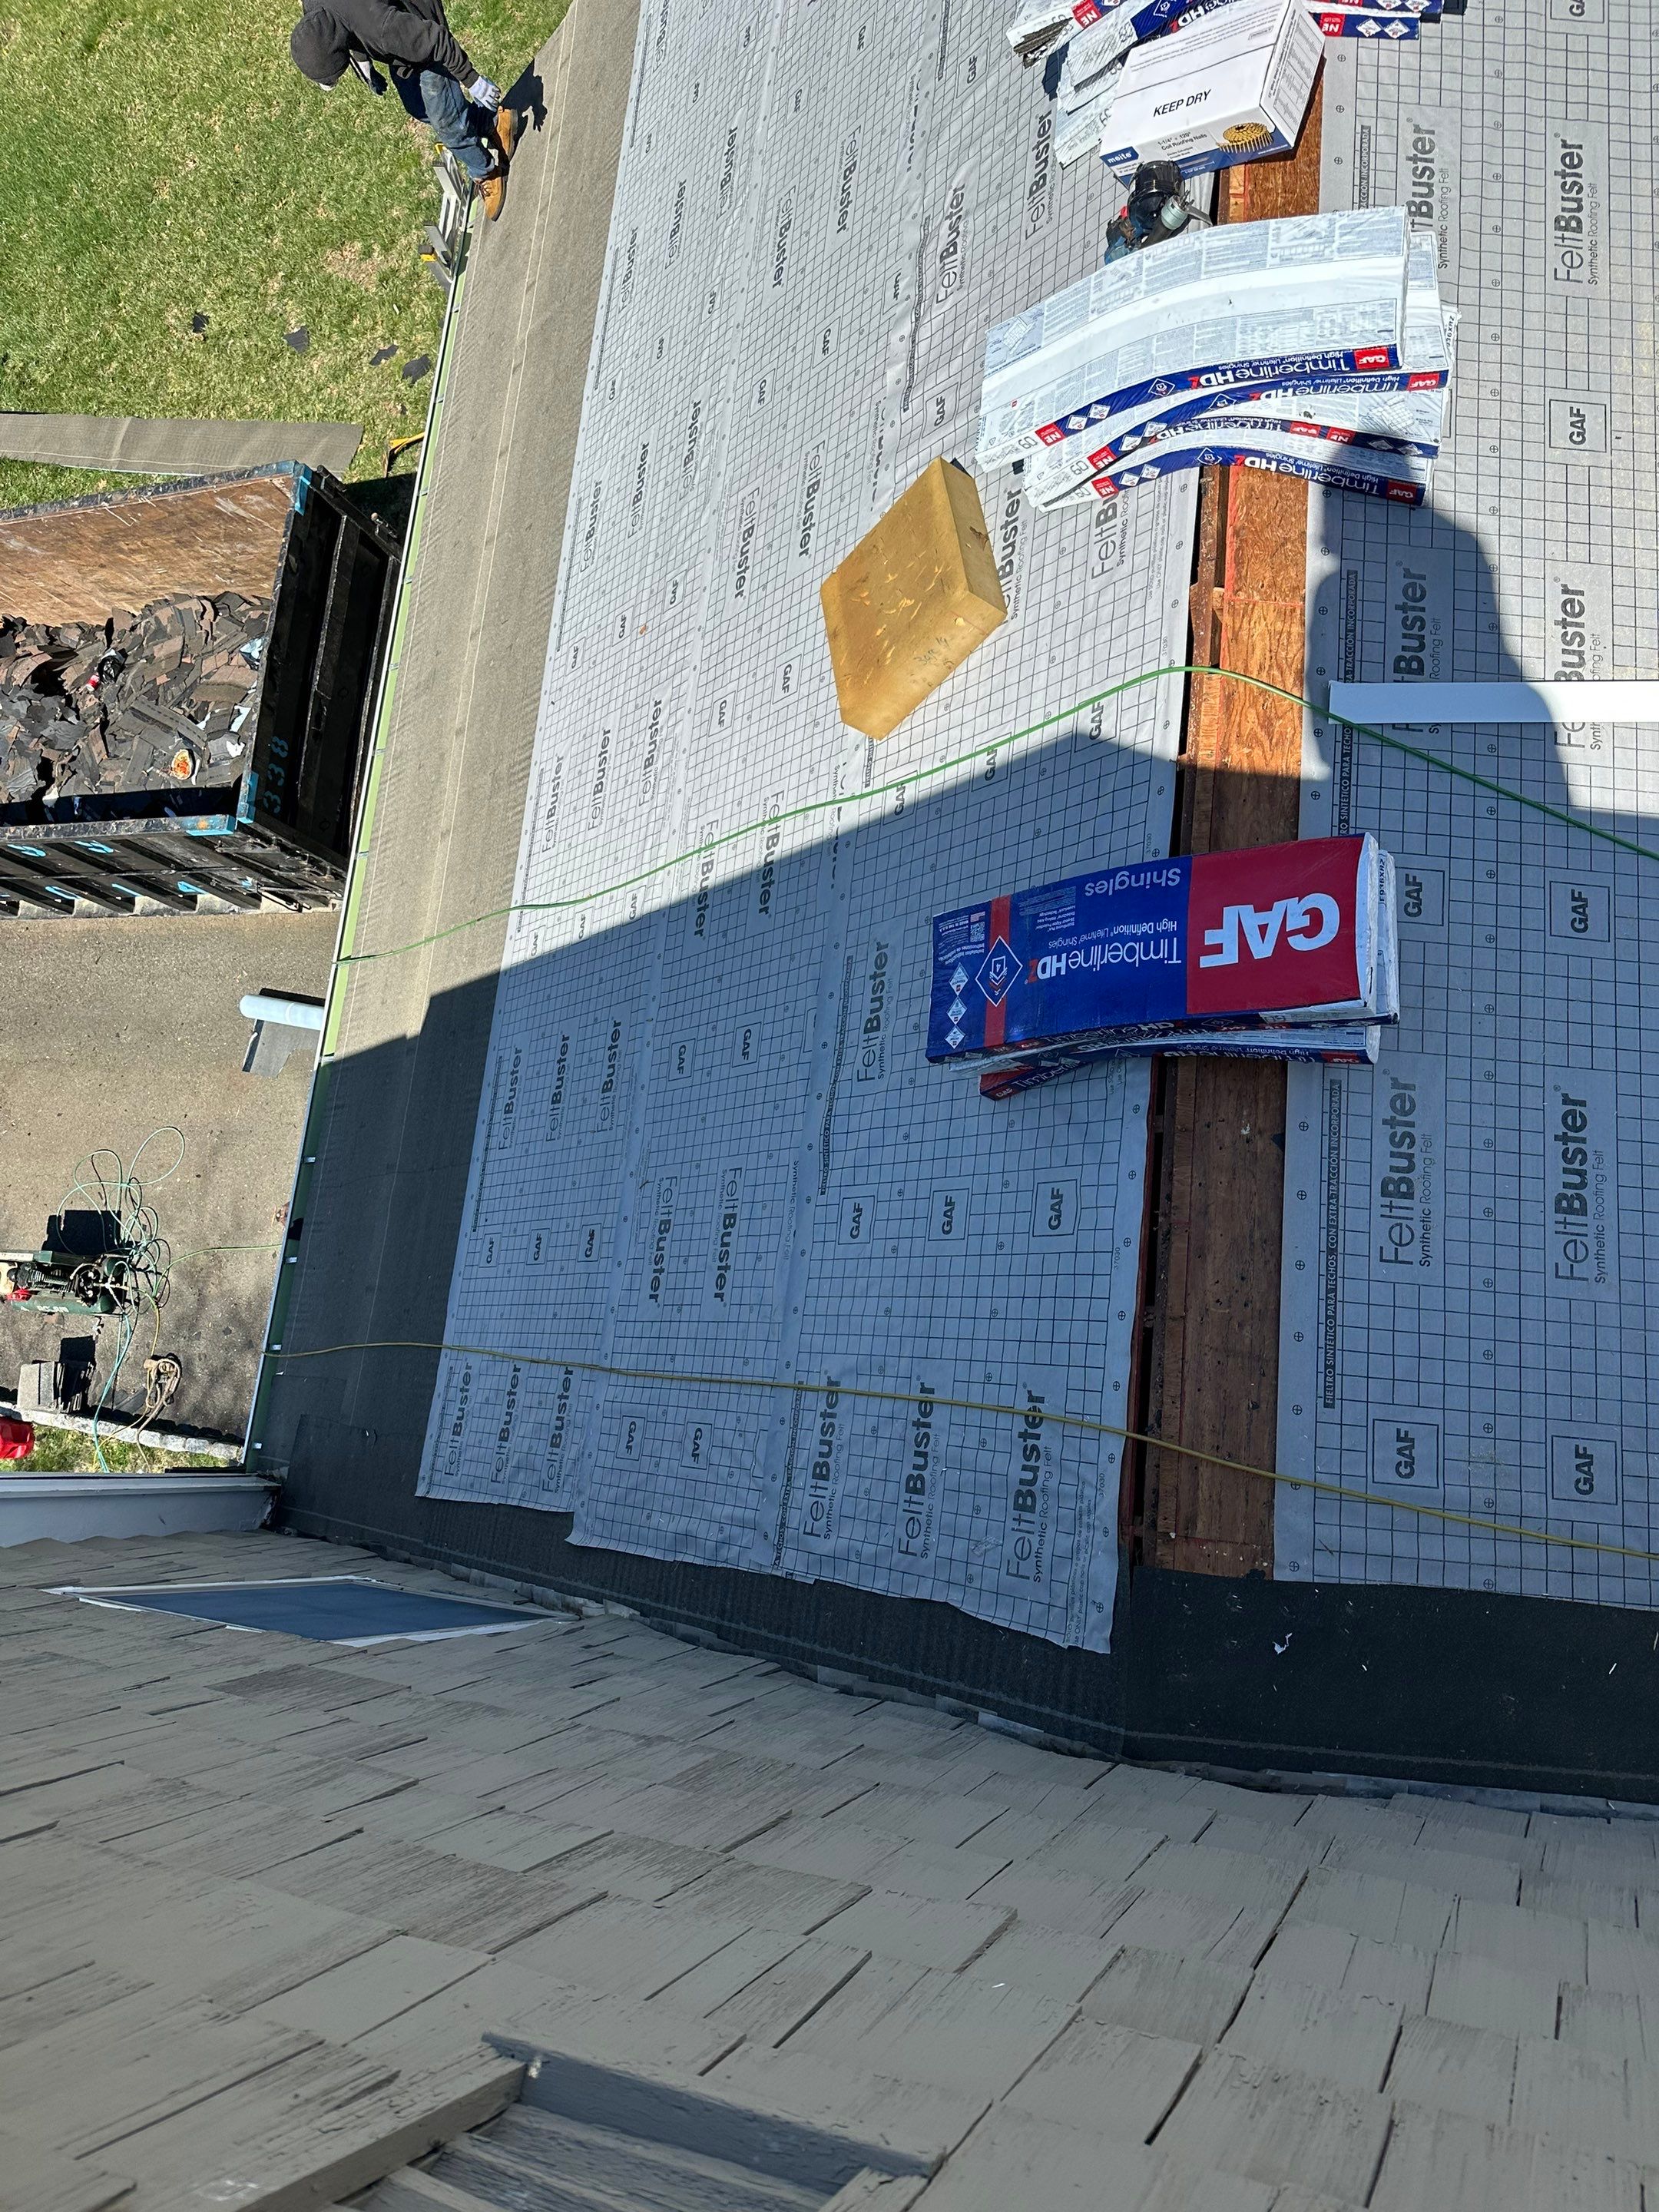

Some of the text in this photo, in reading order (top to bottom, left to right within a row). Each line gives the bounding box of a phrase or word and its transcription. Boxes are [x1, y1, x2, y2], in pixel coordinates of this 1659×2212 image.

[1081, 10, 1098, 25] NE
[1153, 88, 1212, 117] KEEP DRY
[1107, 152, 1132, 164] meite
[1173, 137, 1194, 147] Roofing
[716, 126, 737, 221] FeltBuster
[836, 125, 861, 233] FeltBuster
[1025, 109, 1052, 240] FeltBuster
[1406, 124, 1435, 228] tBuster
[665, 180, 687, 270] FeltBuster
[1438, 168, 1451, 269] Synthetic Roofing Felt
[1555, 139, 1583, 283] FeltBuster
[1590, 198, 1601, 238] Roofing
[773, 185, 796, 289] FeltBuster
[936, 184, 965, 304] FeltBuster
[618, 227, 639, 315] FeltBuster
[1588, 242, 1599, 285] Synthetic
[1359, 355, 1386, 365] GAF
[1410, 379, 1436, 388] GAF
[934, 396, 945, 427] GAF
[1568, 406, 1587, 445] GAF
[679, 400, 701, 501] FeltBuster
[1045, 432, 1062, 444] NE
[628, 442, 649, 538] FeltBuster
[799, 440, 826, 558] FeltBuster
[1100, 484, 1115, 496] NE
[1389, 489, 1415, 498] GAF
[580, 480, 603, 573] FeltBuster
[734, 487, 760, 599] FeltBuster
[1116, 518, 1128, 567] Synthetic
[1015, 537, 1028, 574] Roofing
[1011, 575, 1022, 620] Synthetic
[1346, 574, 1356, 628] INCORPORADA
[1429, 618, 1443, 679] Roofing Felt
[1590, 633, 1603, 680] ofing Felt
[782, 664, 792, 694] GAF
[718, 700, 727, 728] GAF
[1089, 701, 1104, 740] GAF
[639, 699, 662, 806] FeltBuster
[1343, 756, 1352, 777] PARA
[541, 756, 564, 853] FeltBuster
[588, 728, 611, 831] FeltBuster
[1084, 867, 1181, 896] Shingles
[1403, 873, 1423, 918] GAF
[1114, 922, 1154, 935] Definition
[1156, 918, 1177, 933] High
[1200, 892, 1340, 968] GAF
[1571, 889, 1590, 933] GAF
[1048, 935, 1078, 948] Shingles
[856, 941, 889, 1083] FeltBuster
[878, 1035, 887, 1080] Synthetic
[883, 995, 894, 1033] Roofing
[677, 1045, 686, 1075] GAF
[743, 1029, 752, 1061] GAF
[498, 1048, 522, 1151] FeltBuster
[546, 1035, 571, 1142] FeltBuster
[597, 1020, 622, 1134] FeltBuster
[1330, 1084, 1341, 1150] INCORPORADA
[789, 1161, 799, 1207] Synthetic
[1379, 1077, 1416, 1266] FeltBuster
[1555, 1092, 1589, 1283] FeltBuster
[849, 1200, 863, 1240] GAF
[942, 1195, 955, 1235] GAF
[1048, 1187, 1065, 1230] GAF
[1419, 1133, 1435, 1267] Synthetic Roofing Felt
[1594, 1149, 1608, 1284] Synthetic Roofing Felt
[485, 1237, 494, 1264] GAF
[533, 1235, 542, 1261] GAF
[584, 1229, 595, 1257] GAF
[648, 1177, 678, 1304] FeltBuster
[714, 1167, 743, 1303] FeltBuster
[1329, 1230, 1337, 1250] CON
[1327, 1295, 1336, 1316] PARA
[1326, 1368, 1335, 1404] FIELTRO
[444, 1362, 474, 1477] FeltBuster
[491, 1363, 522, 1483] FeltBuster
[542, 1366, 575, 1493] FeltBuster
[624, 1421, 637, 1455] GAF
[691, 1427, 703, 1464] GAF
[803, 1376, 841, 1538] FeltBuster
[899, 1382, 935, 1557] FeltBuster
[1396, 1428, 1416, 1479] GAF
[1575, 1444, 1594, 1495] GAF
[824, 1424, 845, 1540] Synthetic Roofing Felt
[920, 1433, 941, 1559] Synthetic Roofing Felt
[1006, 1388, 1046, 1581] FeltBuster
[1032, 1445, 1053, 1583] Synthetic Roofing Felt
